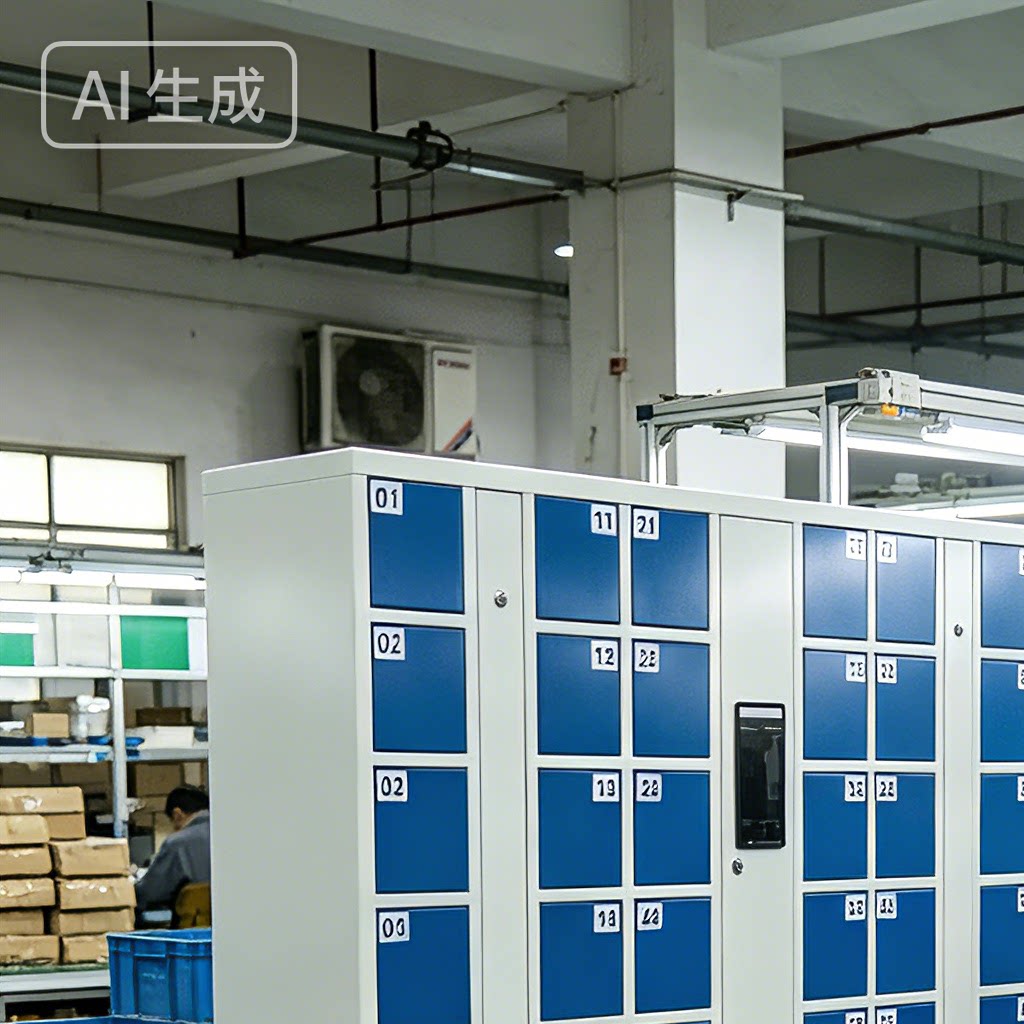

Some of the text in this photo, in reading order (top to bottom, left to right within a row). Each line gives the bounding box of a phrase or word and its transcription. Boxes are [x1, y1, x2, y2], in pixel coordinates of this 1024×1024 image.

[376, 487, 397, 508] 01
[594, 511, 611, 529] 11
[637, 516, 654, 534] 21
[378, 633, 401, 654] 02
[595, 647, 614, 665] 12
[381, 776, 403, 796] 02
